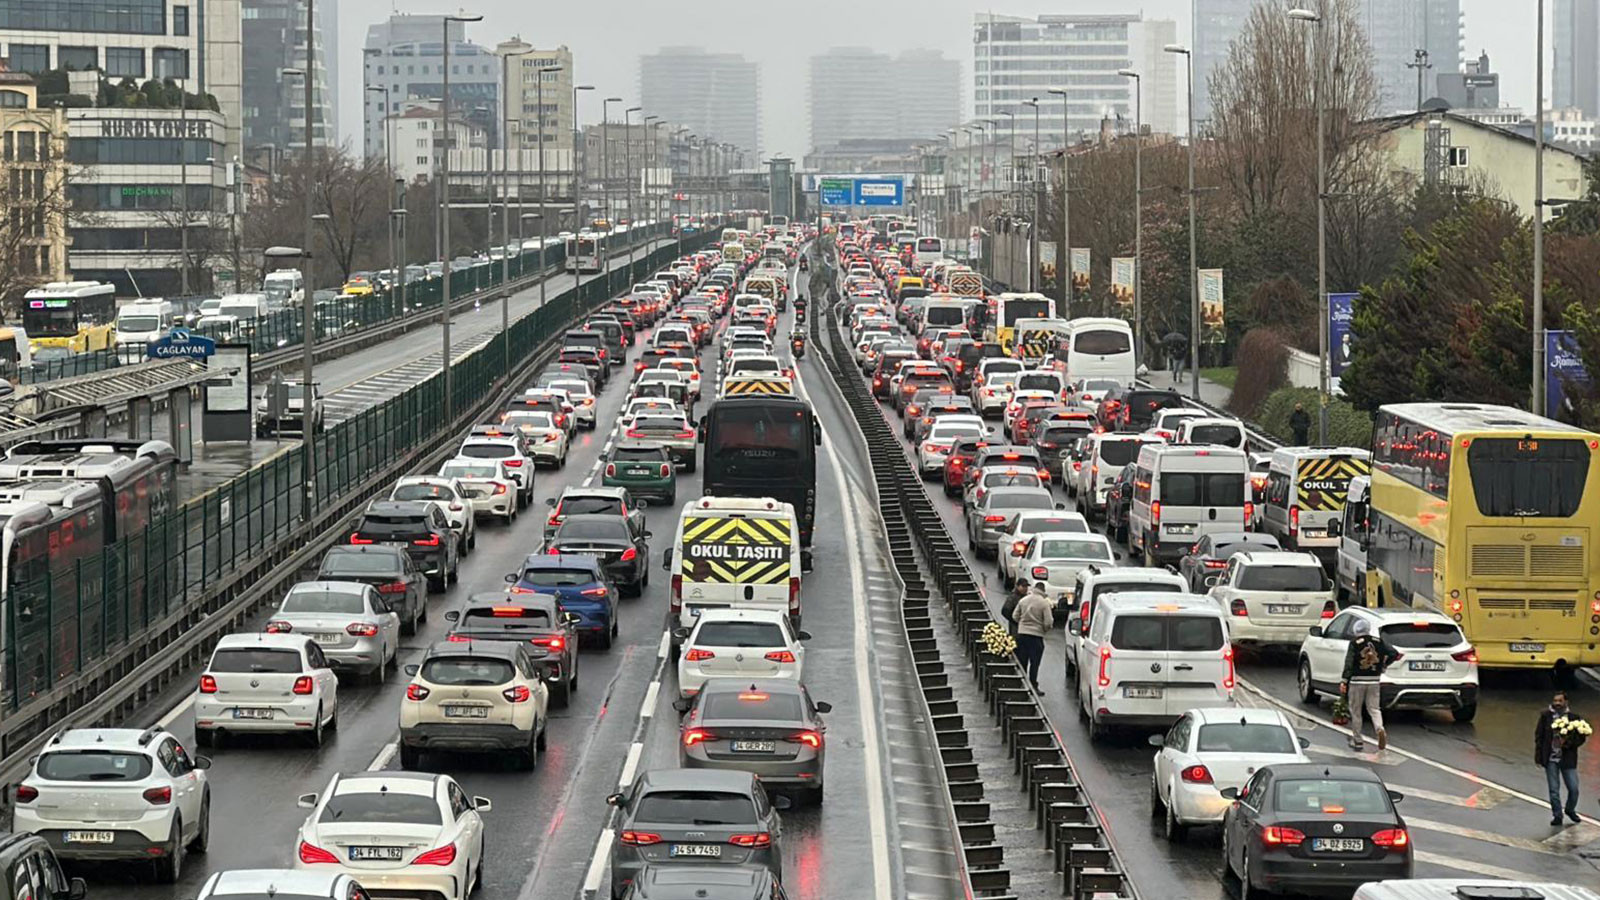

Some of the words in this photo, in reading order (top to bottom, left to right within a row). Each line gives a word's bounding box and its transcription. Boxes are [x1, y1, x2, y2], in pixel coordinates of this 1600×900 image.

[156, 344, 205, 357] ÇAĞLAYAN
[1303, 481, 1336, 490] OKUL
[691, 544, 731, 558] OKUL
[736, 546, 783, 560] TAŞITI
[1342, 840, 1361, 849] 6925
[355, 847, 364, 856] 34
[368, 847, 381, 857] FYL
[676, 845, 685, 853] 34
[687, 845, 697, 853] SK
[699, 846, 719, 855] 7459
